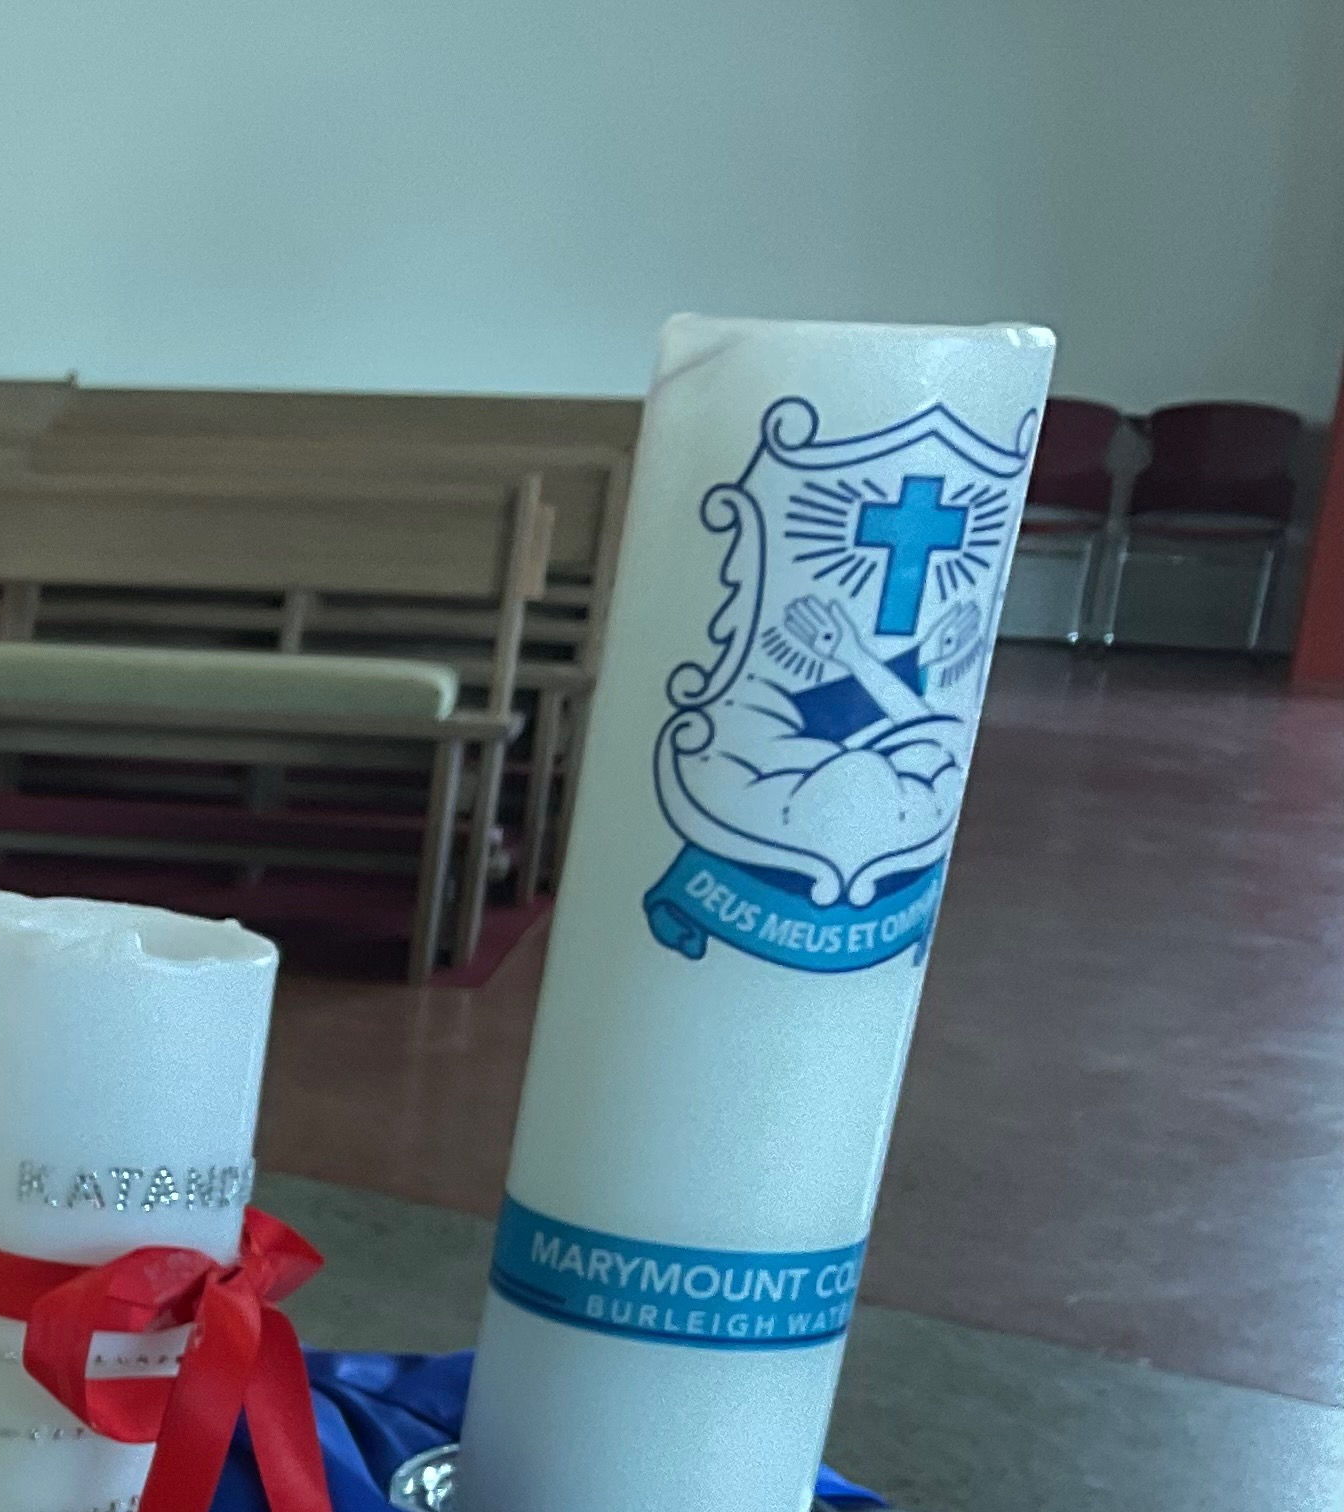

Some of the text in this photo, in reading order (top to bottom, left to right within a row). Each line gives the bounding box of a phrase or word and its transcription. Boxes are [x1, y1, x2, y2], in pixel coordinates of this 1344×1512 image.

[685, 869, 761, 932] DEUS
[762, 912, 843, 953] MEUS
[847, 920, 878, 954] ET
[530, 1230, 810, 1303] MARYMOUNT
[586, 1294, 775, 1338] BURLEIGH
